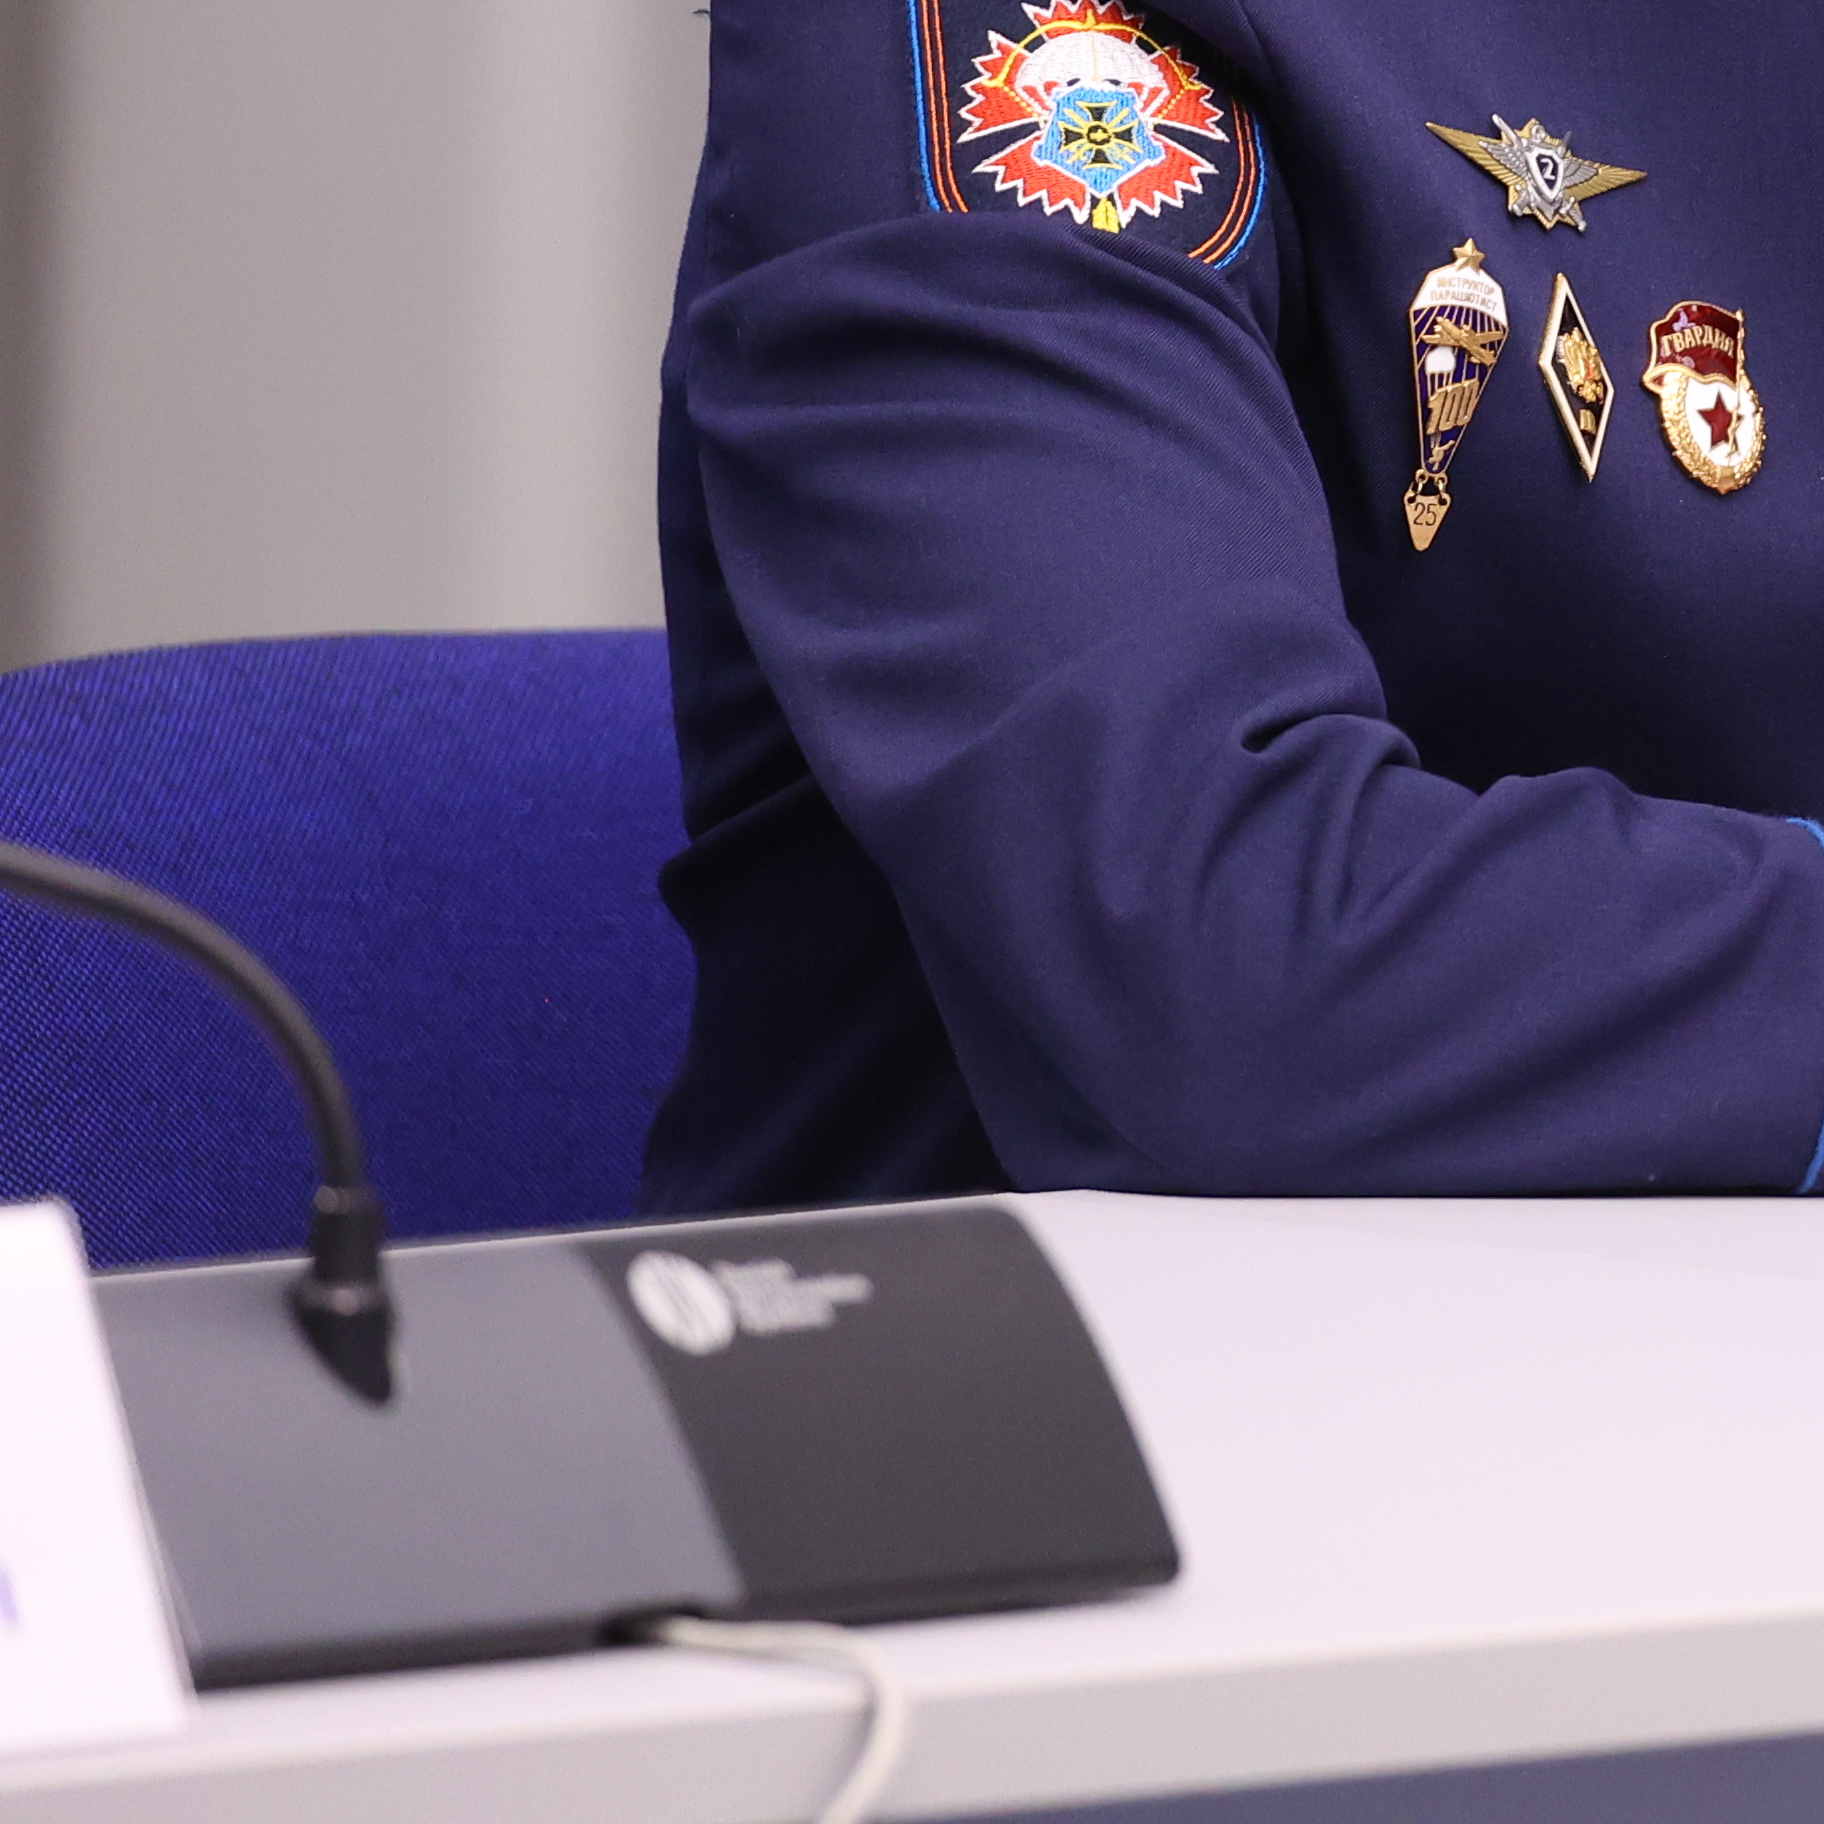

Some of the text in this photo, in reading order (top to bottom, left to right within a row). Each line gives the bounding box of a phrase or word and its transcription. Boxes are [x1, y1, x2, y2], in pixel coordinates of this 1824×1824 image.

[1540, 158, 1556, 181] 2
[1436, 276, 1496, 295] ИНСТРУКТОР
[1430, 288, 1498, 312] ПАРАШЮТИСТ
[1661, 323, 1736, 359] ГВАРДИЯ
[1426, 378, 1480, 436] 100
[1413, 502, 1438, 526] 25
